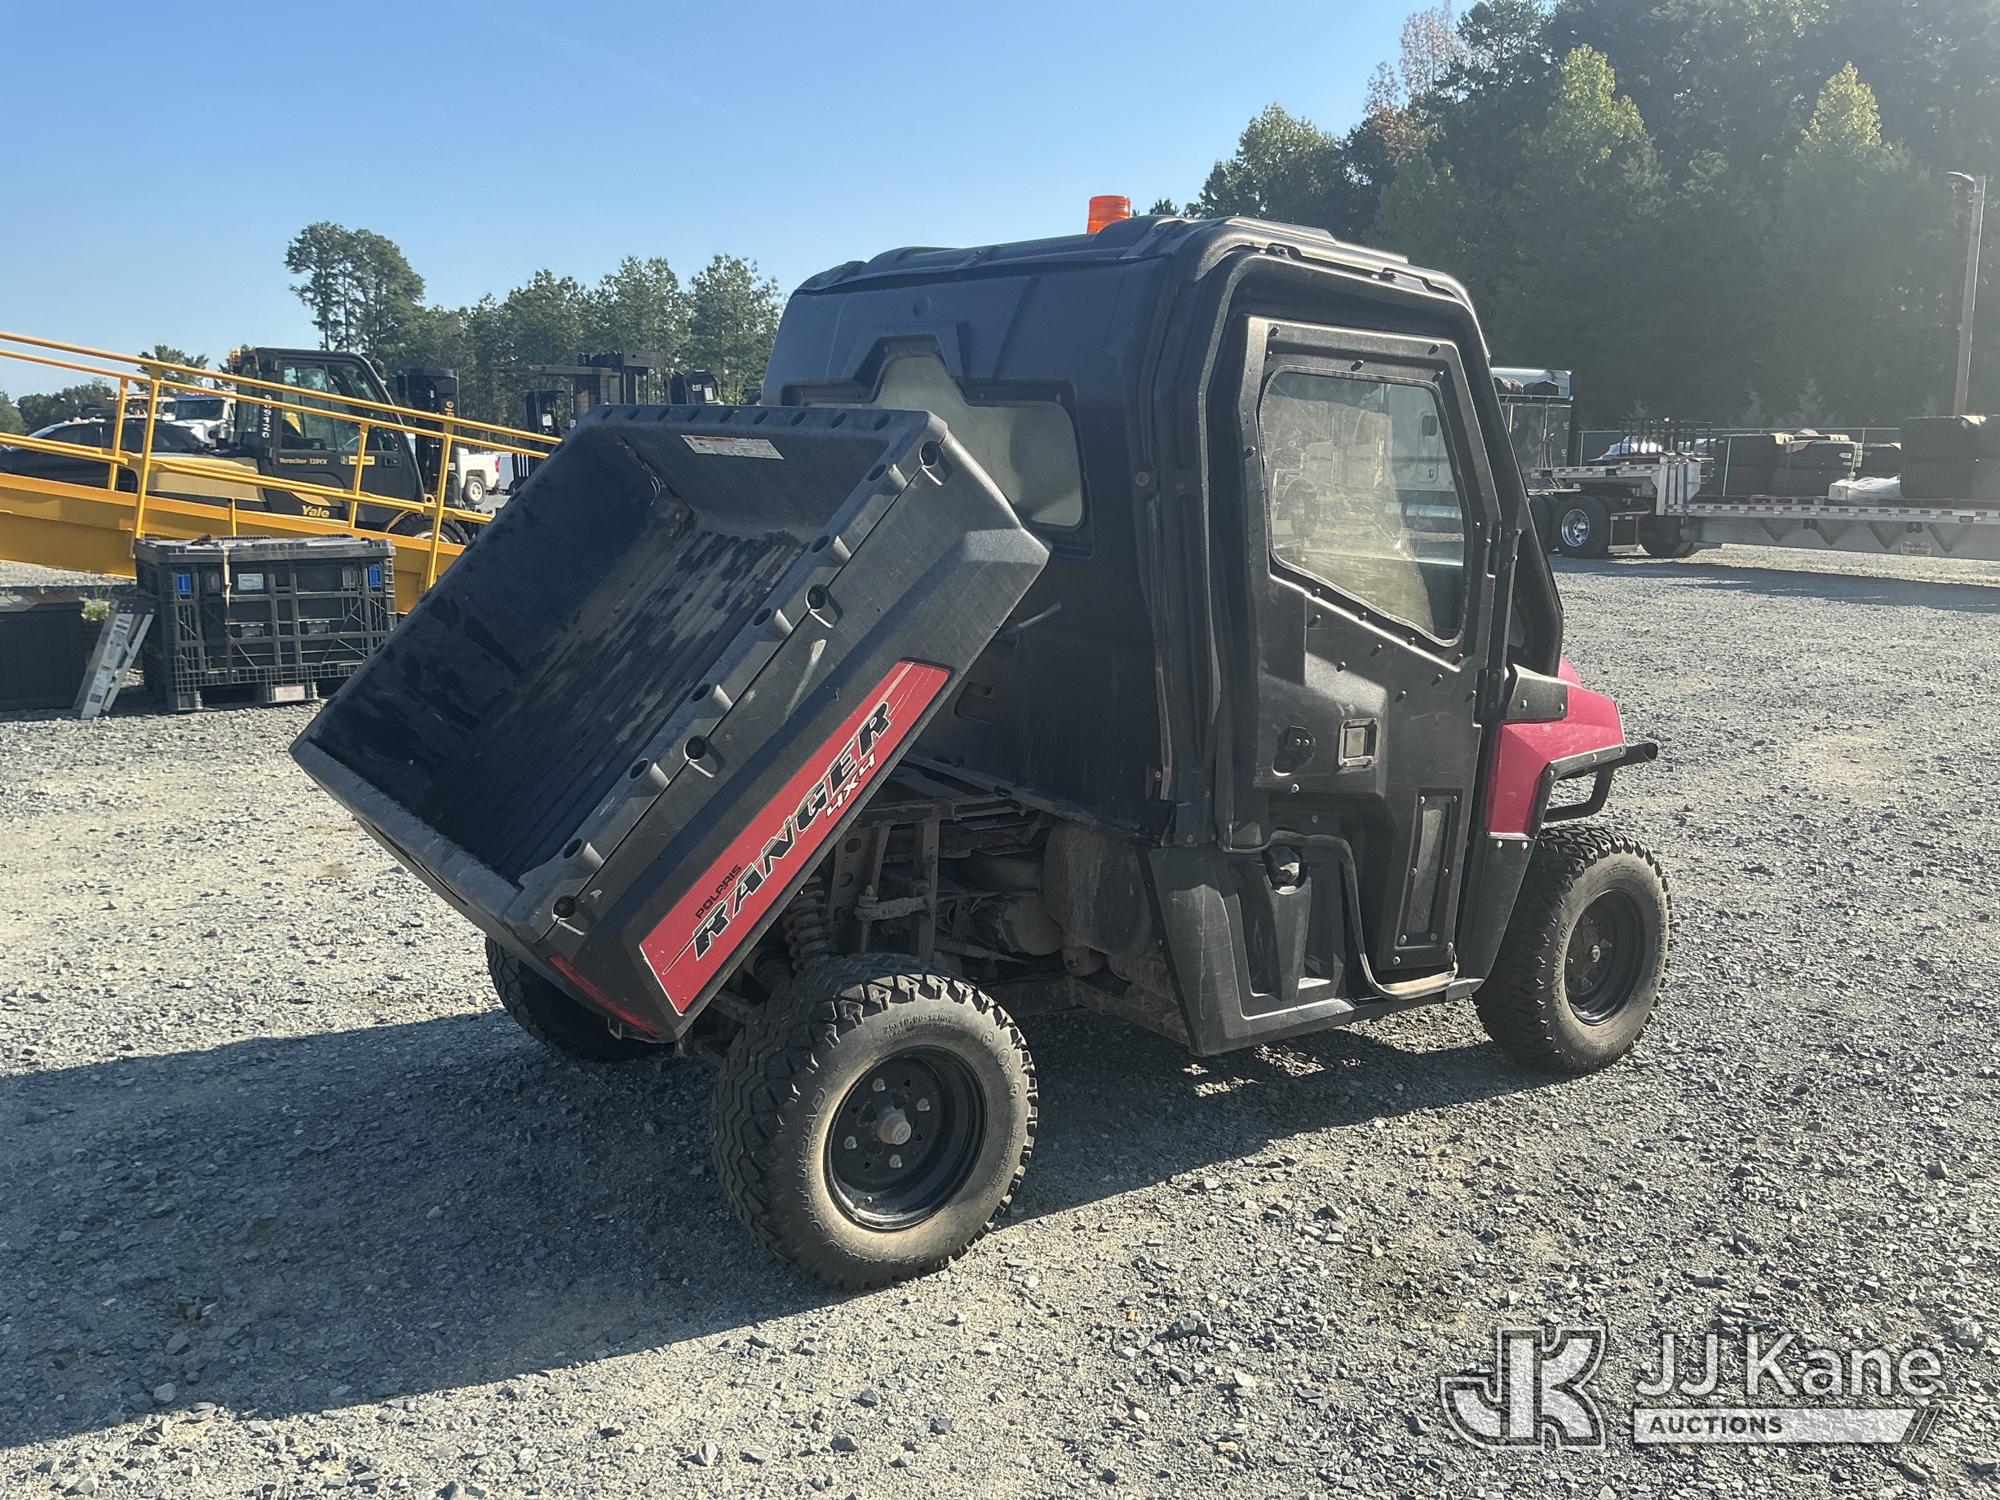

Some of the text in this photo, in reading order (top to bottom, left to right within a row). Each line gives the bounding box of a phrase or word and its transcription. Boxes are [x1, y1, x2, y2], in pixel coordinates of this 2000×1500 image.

[302, 505, 330, 518] Yale
[692, 701, 891, 961] RANGER
[696, 864, 742, 919] POLARIS
